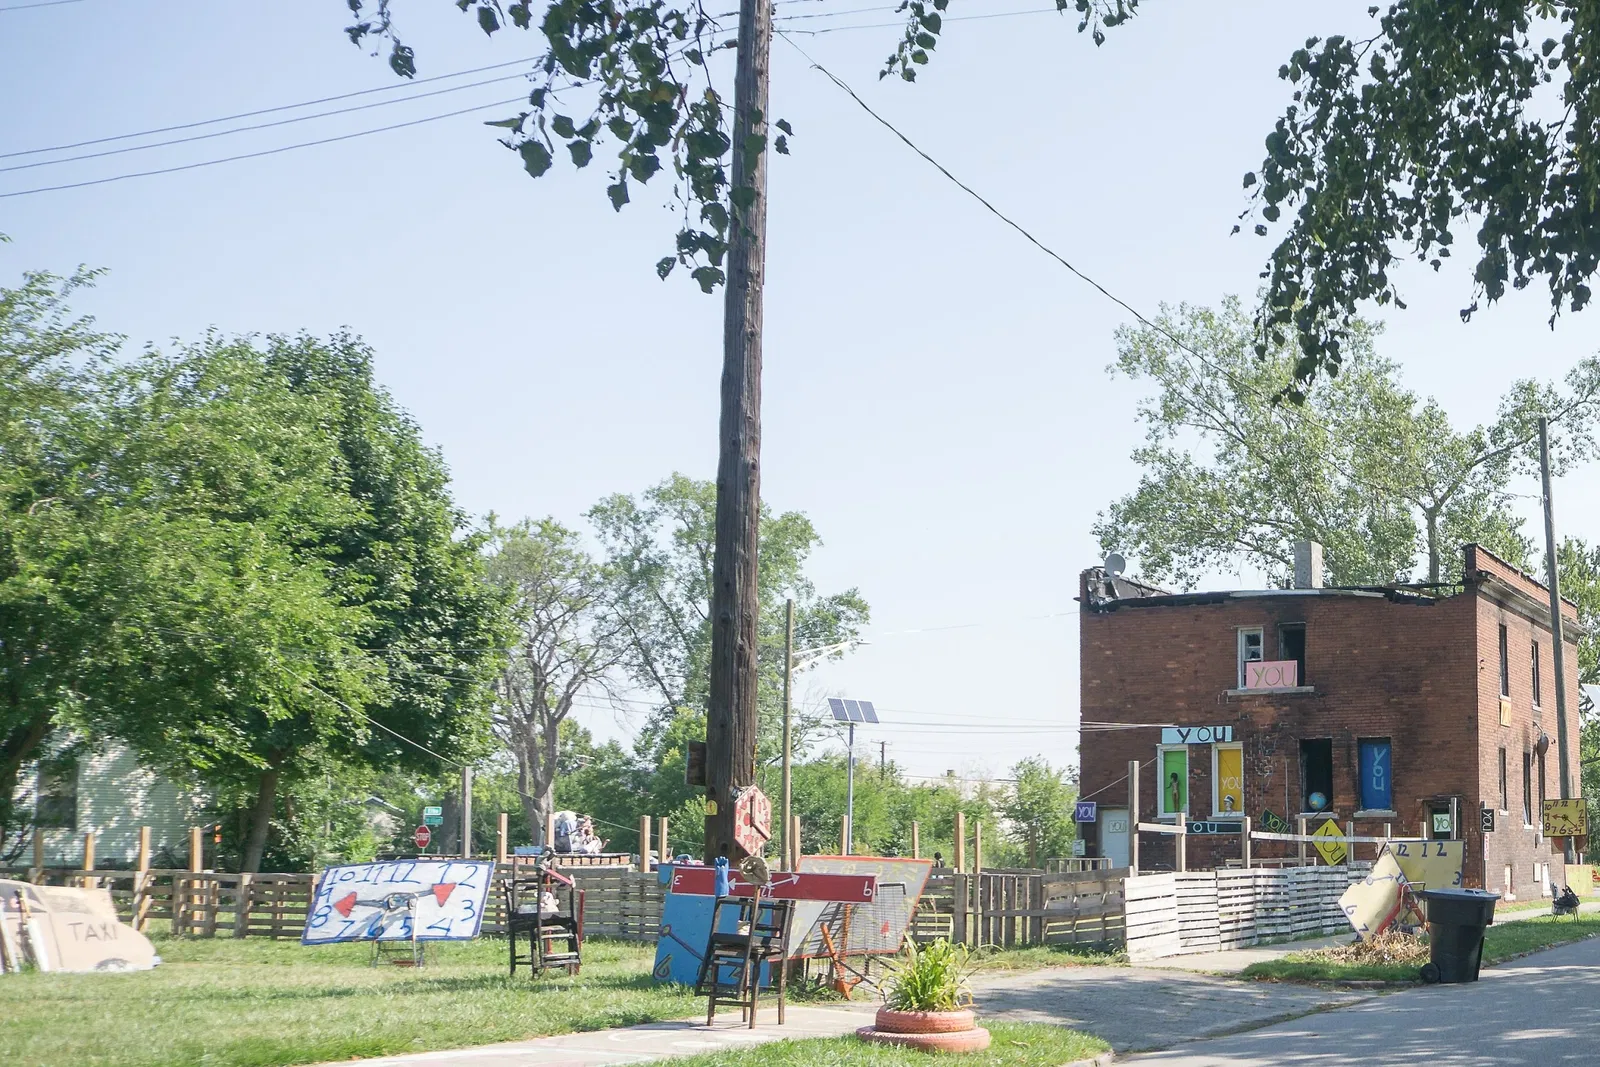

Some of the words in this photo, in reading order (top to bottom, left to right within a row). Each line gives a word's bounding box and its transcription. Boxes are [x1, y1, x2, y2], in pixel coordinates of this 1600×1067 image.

[1252, 664, 1296, 687] YOU
[1176, 726, 1226, 743] YOU
[1373, 747, 1387, 791] YOU
[1221, 776, 1243, 790] YOU
[1078, 806, 1094, 818] YOU
[1482, 811, 1493, 831] YOU
[1192, 822, 1217, 832] OU
[1267, 814, 1289, 834] YOU
[1435, 817, 1451, 831] YO
[1545, 822, 1550, 831] 8
[1552, 826, 1557, 834] 7
[1559, 824, 1566, 834] 6
[416, 832, 429, 841] STOP
[1323, 826, 1347, 863] YOU
[1396, 844, 1410, 857] 12
[1421, 843, 1428, 857] 1
[1436, 842, 1448, 857] 2
[327, 869, 356, 886] 10
[438, 863, 453, 884] 1
[458, 866, 478, 889] 2
[1452, 871, 1463, 885] 3
[311, 905, 332, 928] 8
[461, 900, 475, 921] 3
[68, 922, 118, 942] TAXI
[336, 920, 355, 938] 7
[368, 914, 385, 937] 6
[400, 916, 415, 936] 5
[426, 917, 453, 937] 4
[653, 953, 672, 980] 6
